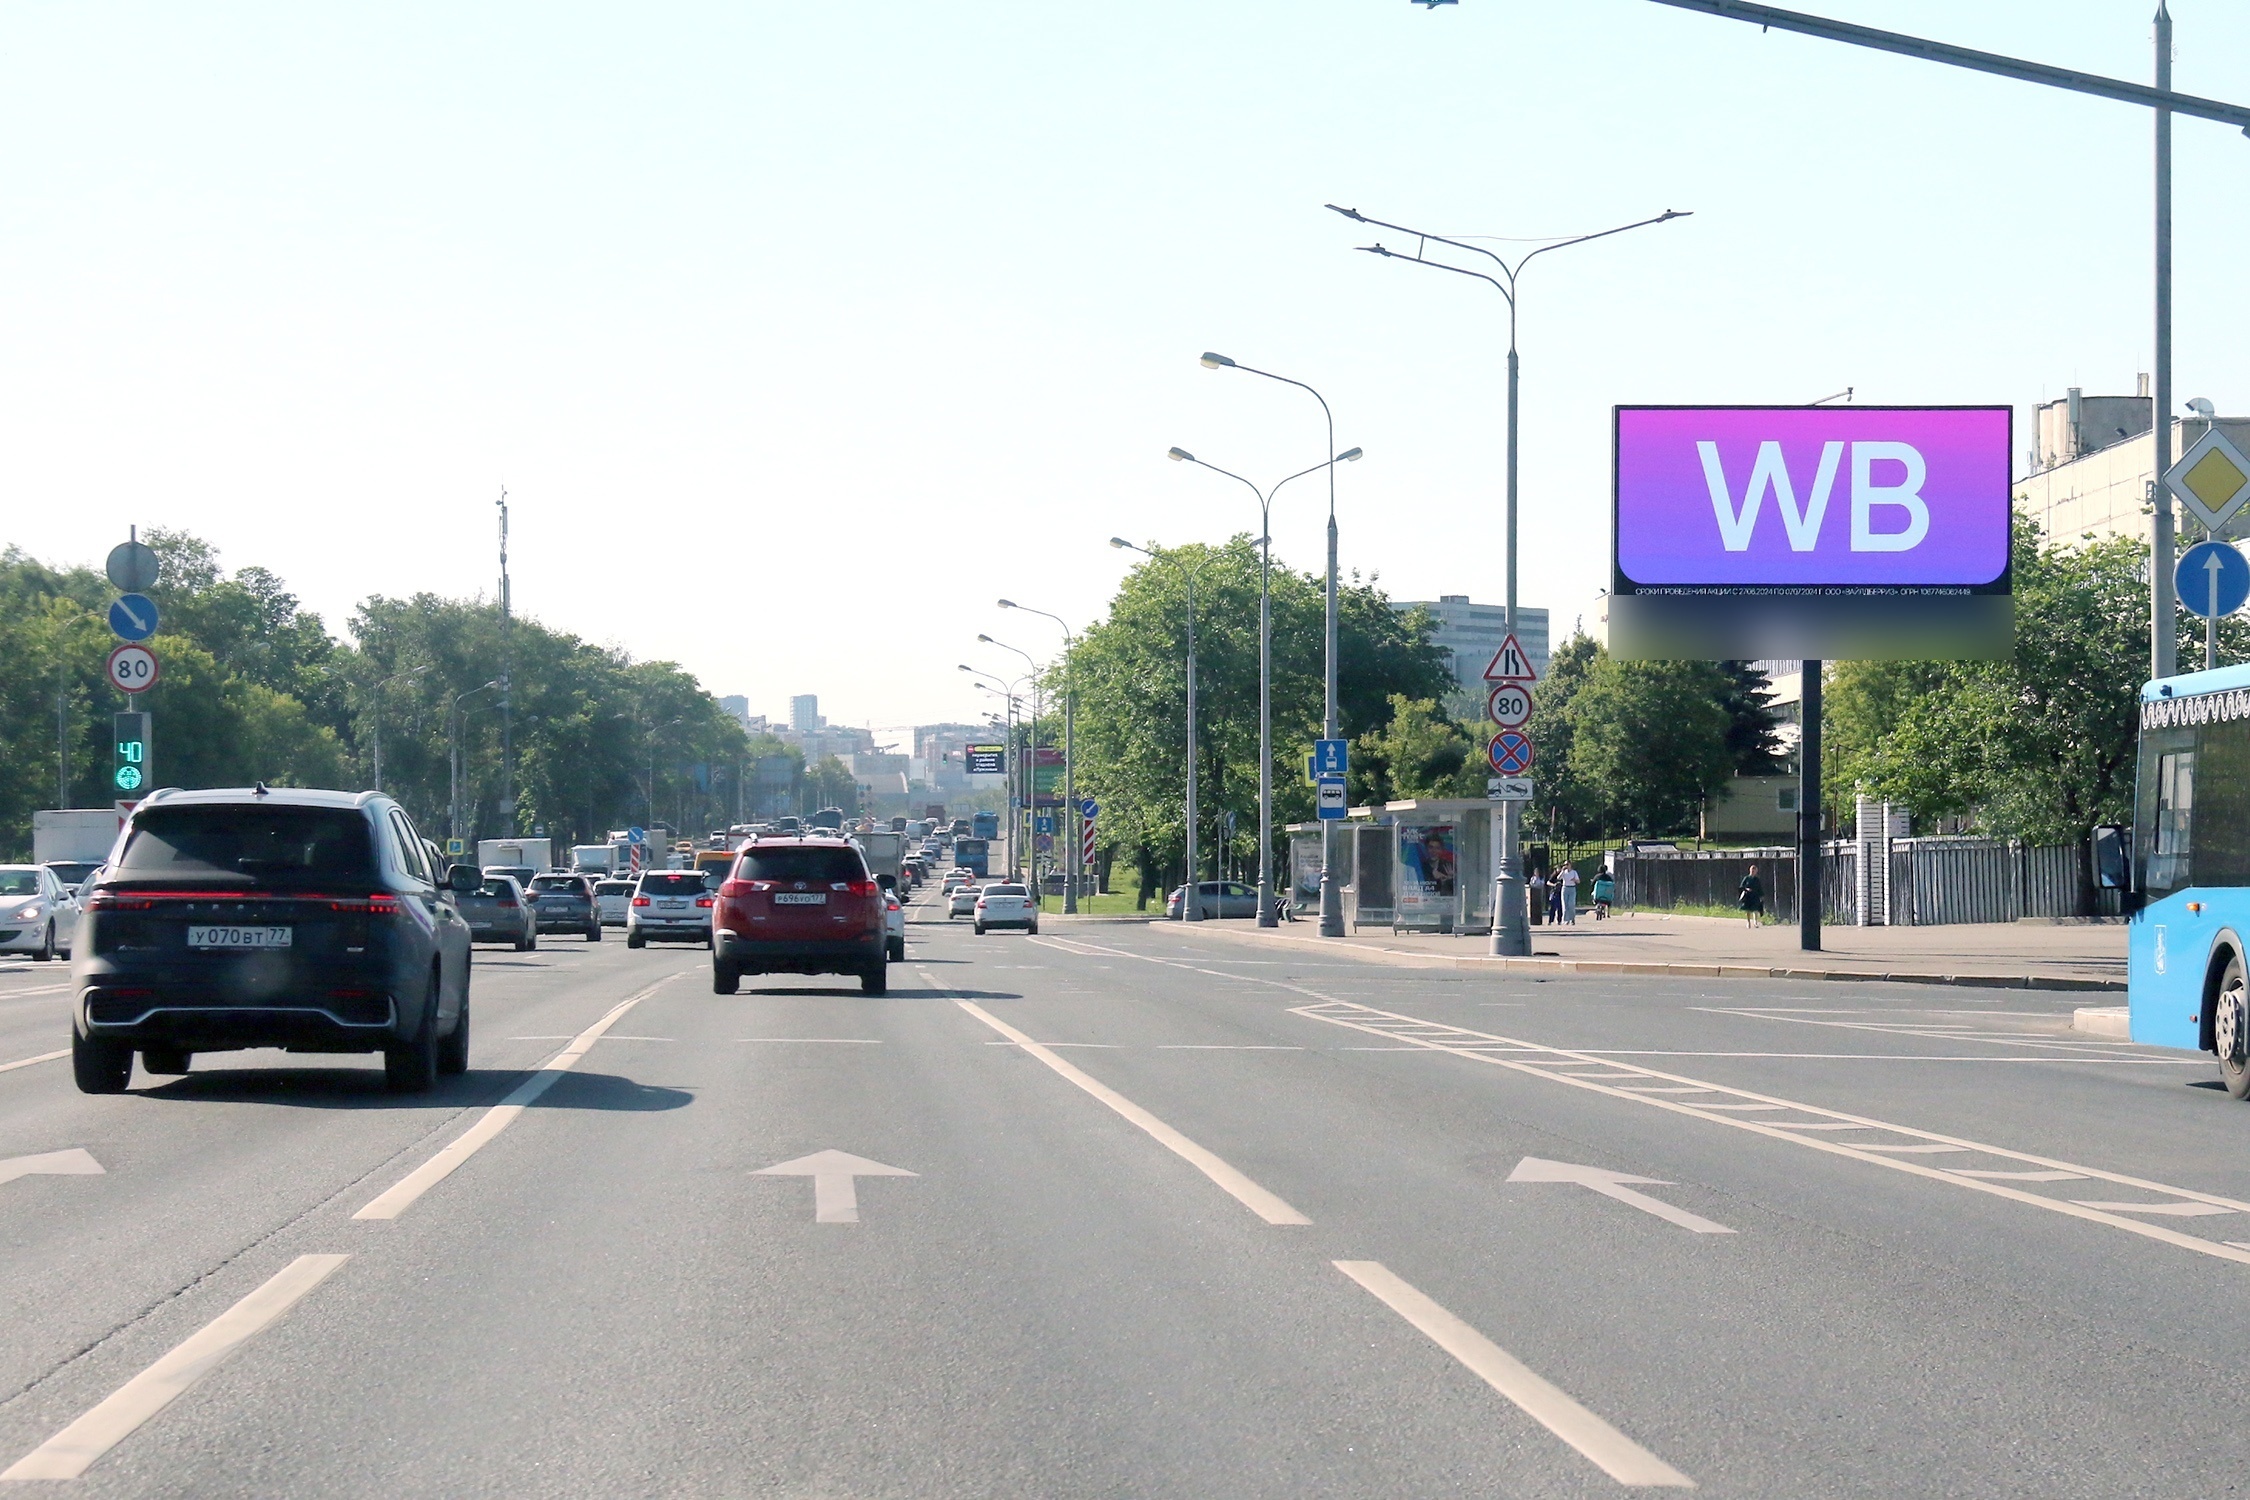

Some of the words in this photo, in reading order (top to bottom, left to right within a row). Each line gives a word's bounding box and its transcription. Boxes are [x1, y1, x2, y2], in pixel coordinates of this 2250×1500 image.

[1696, 440, 1931, 552] WB
[118, 660, 148, 678] 80
[1498, 698, 1523, 715] 80
[119, 742, 142, 763] 40
[196, 928, 263, 944] У070ВТ
[270, 928, 286, 940] 77
